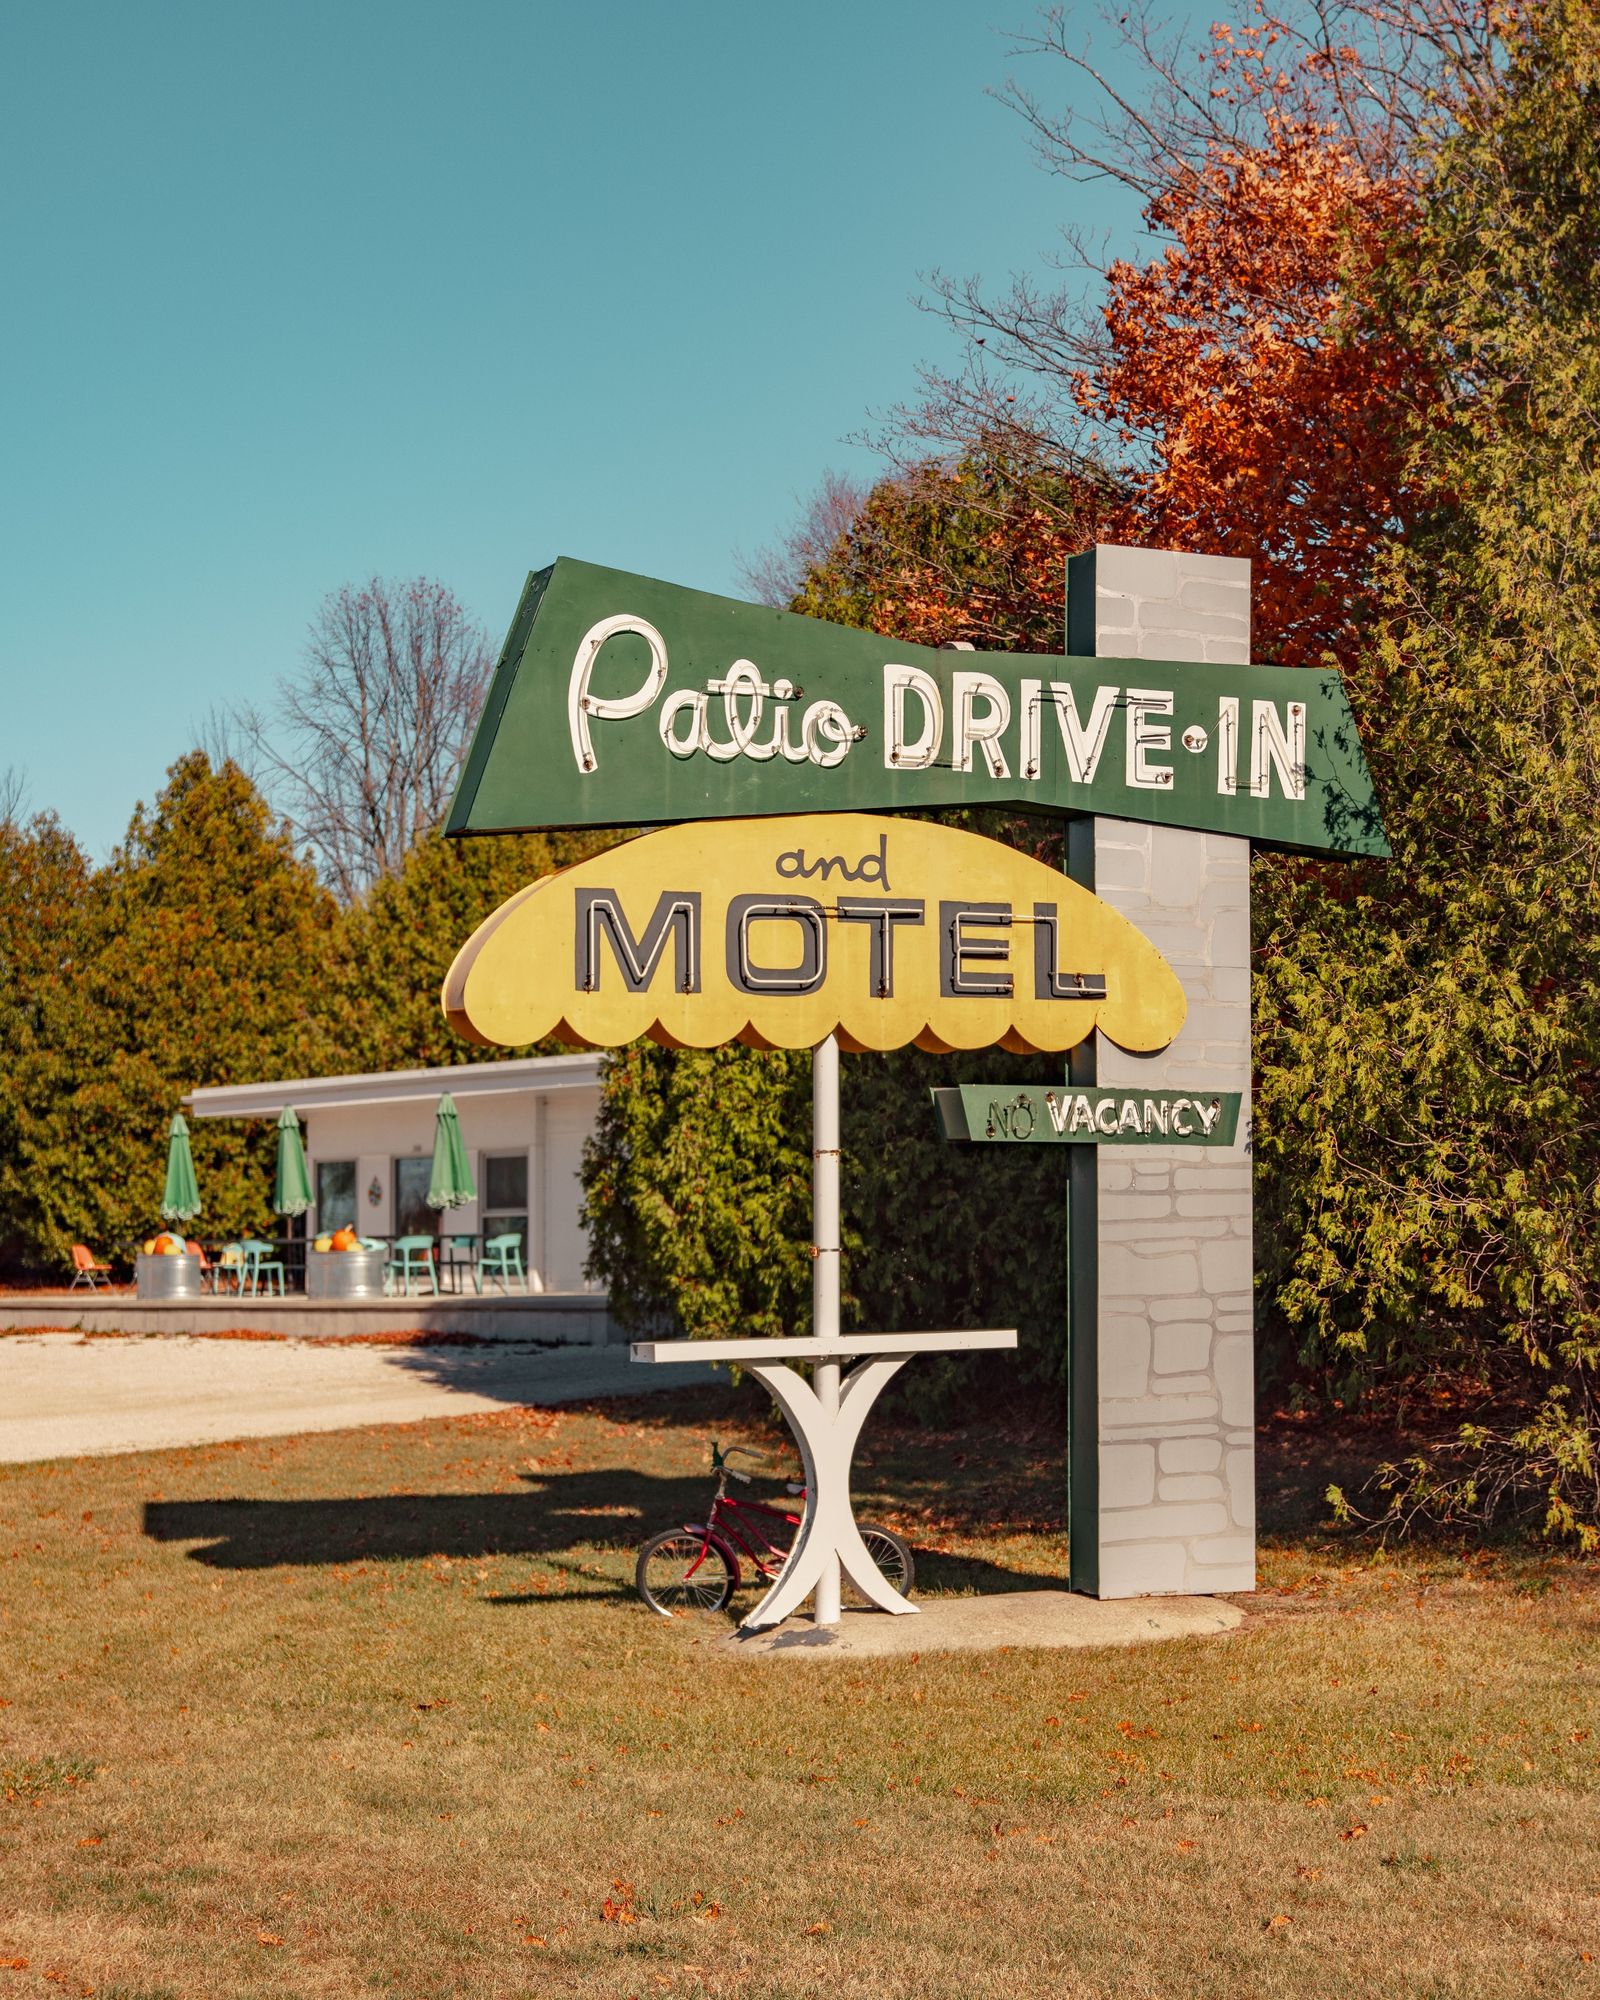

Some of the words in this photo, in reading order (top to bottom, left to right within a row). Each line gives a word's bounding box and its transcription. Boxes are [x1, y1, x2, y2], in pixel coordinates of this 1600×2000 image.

[568, 613, 867, 774] Patio
[775, 834, 892, 892] and
[574, 887, 1109, 1000] MOTEL
[986, 1096, 1038, 1139] NO
[1046, 1094, 1220, 1136] VACANCY
